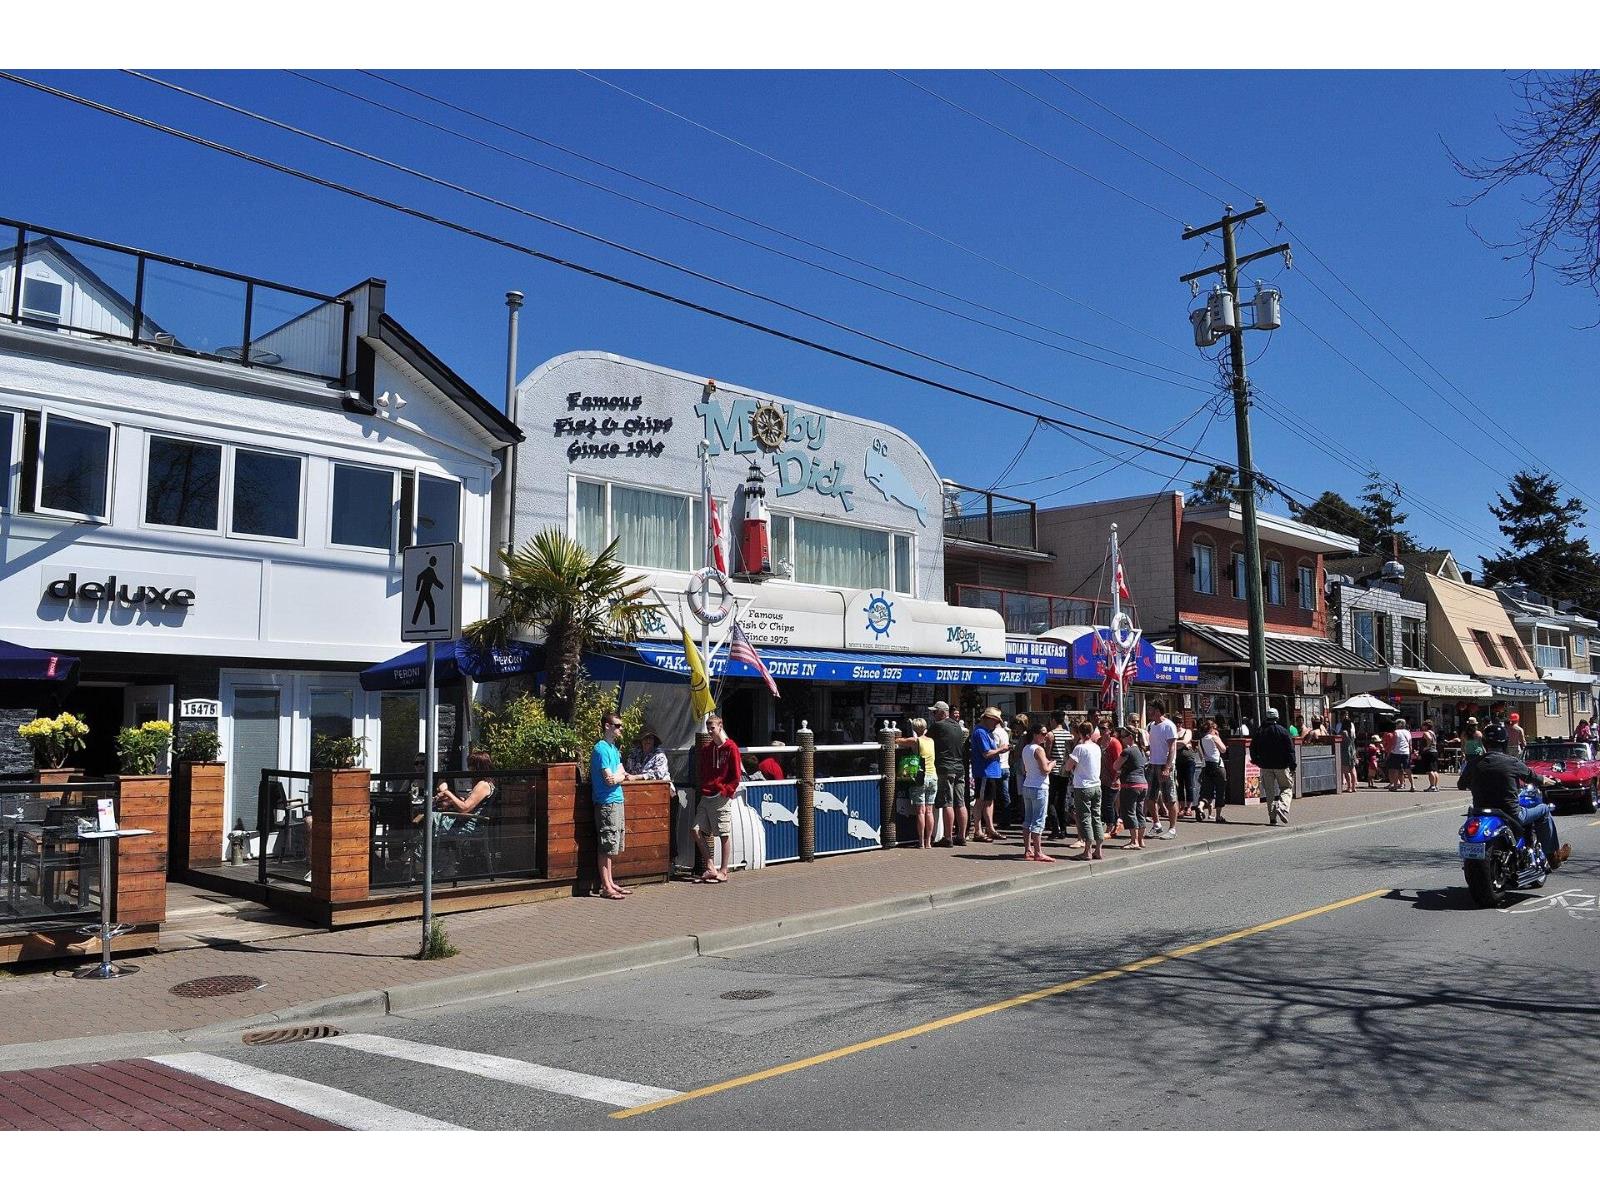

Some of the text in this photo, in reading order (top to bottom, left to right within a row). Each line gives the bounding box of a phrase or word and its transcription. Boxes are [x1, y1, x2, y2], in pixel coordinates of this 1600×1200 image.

[566, 392, 642, 409] Famous
[553, 416, 673, 437] Fish & Chips
[567, 440, 620, 459] Since
[772, 450, 854, 512] Dick
[48, 573, 196, 607] deluxe
[749, 610, 784, 620] Famous
[759, 621, 767, 630] &
[770, 622, 795, 633] Chips
[744, 632, 789, 645] Since 1975
[947, 627, 976, 642] Moby
[960, 640, 982, 654] Dick
[1006, 643, 1067, 657] INDIAN BREAKFAST
[493, 655, 522, 665] PERONI
[393, 667, 420, 680] PERONI
[769, 661, 817, 676] DINE IN
[853, 666, 903, 679] Since 1975
[936, 670, 973, 681] DINE IN
[999, 671, 1039, 683] TAKE OUT
[184, 703, 216, 715] 15475
